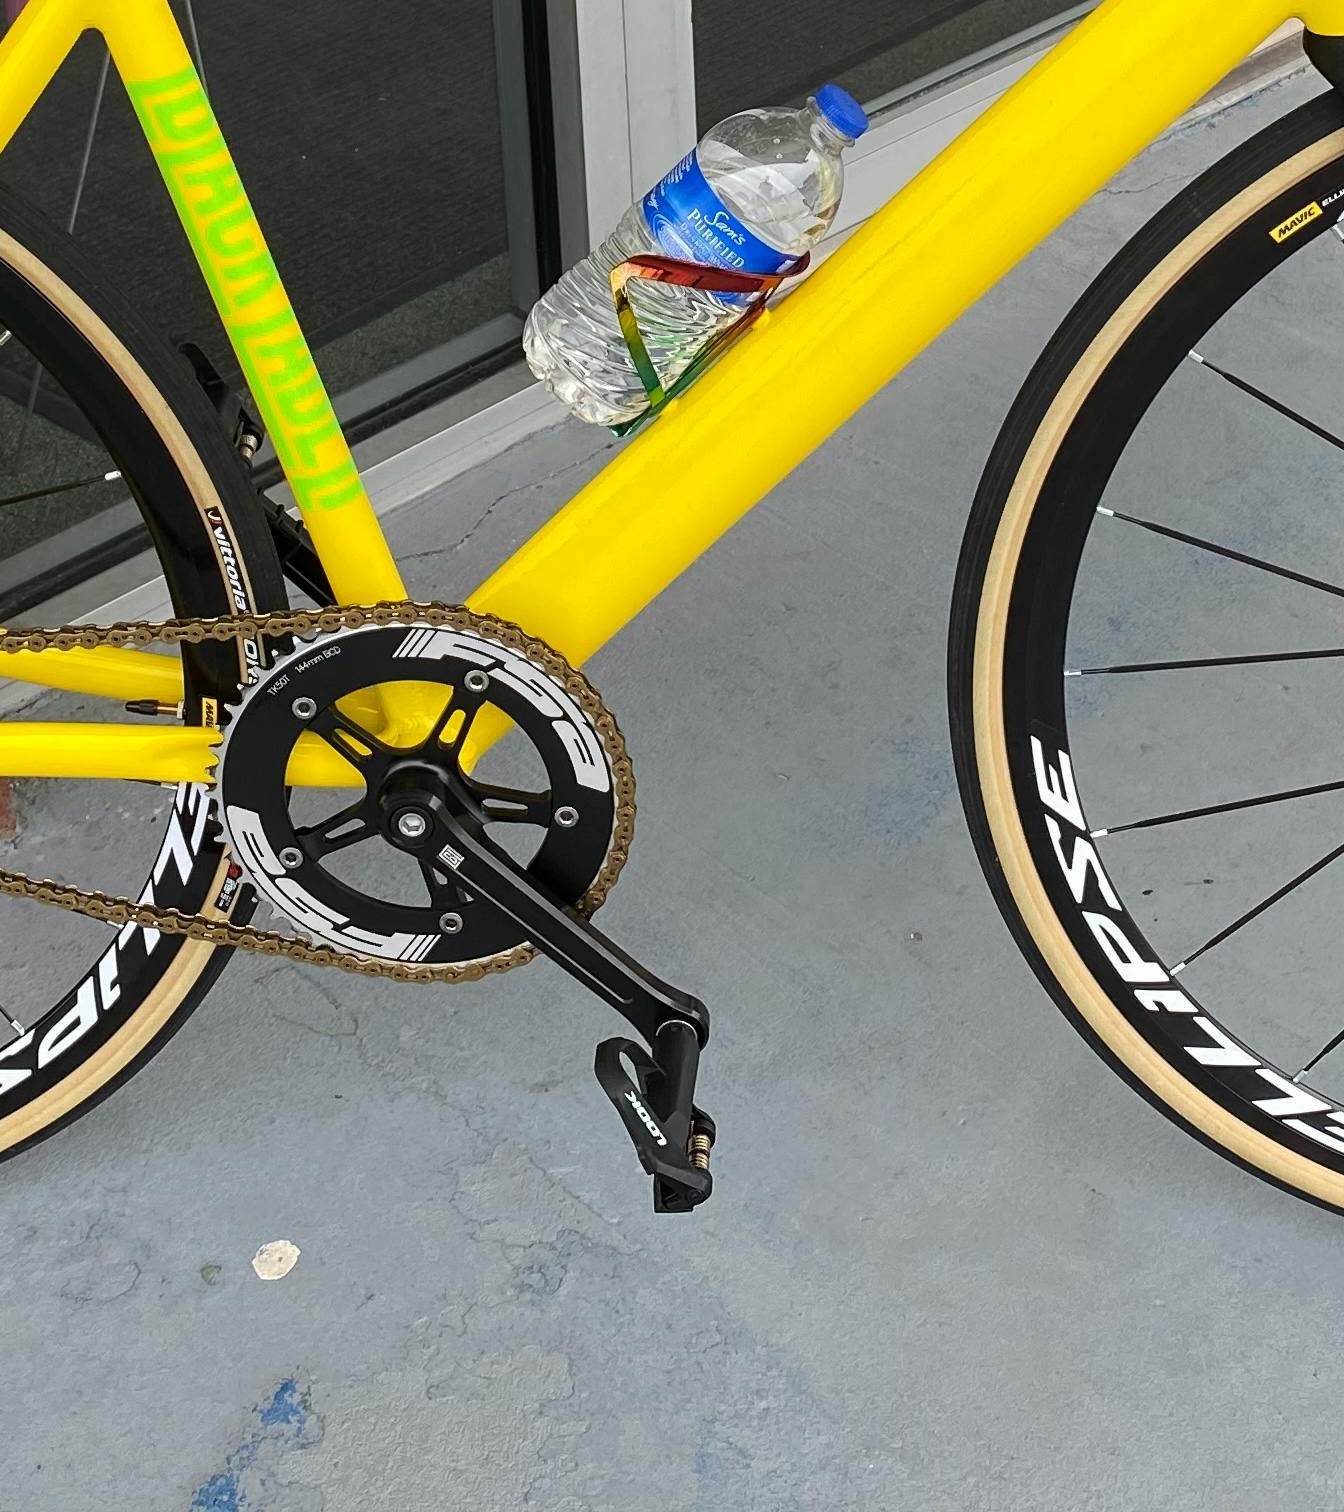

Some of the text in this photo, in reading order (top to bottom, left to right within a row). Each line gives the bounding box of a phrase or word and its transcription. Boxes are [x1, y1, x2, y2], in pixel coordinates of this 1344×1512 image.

[687, 207, 746, 269] PURIFIED
[703, 211, 747, 246] Sam's
[1277, 207, 1316, 238] MAVIC
[212, 520, 244, 612] vittoria
[623, 1090, 668, 1148] LOOK
